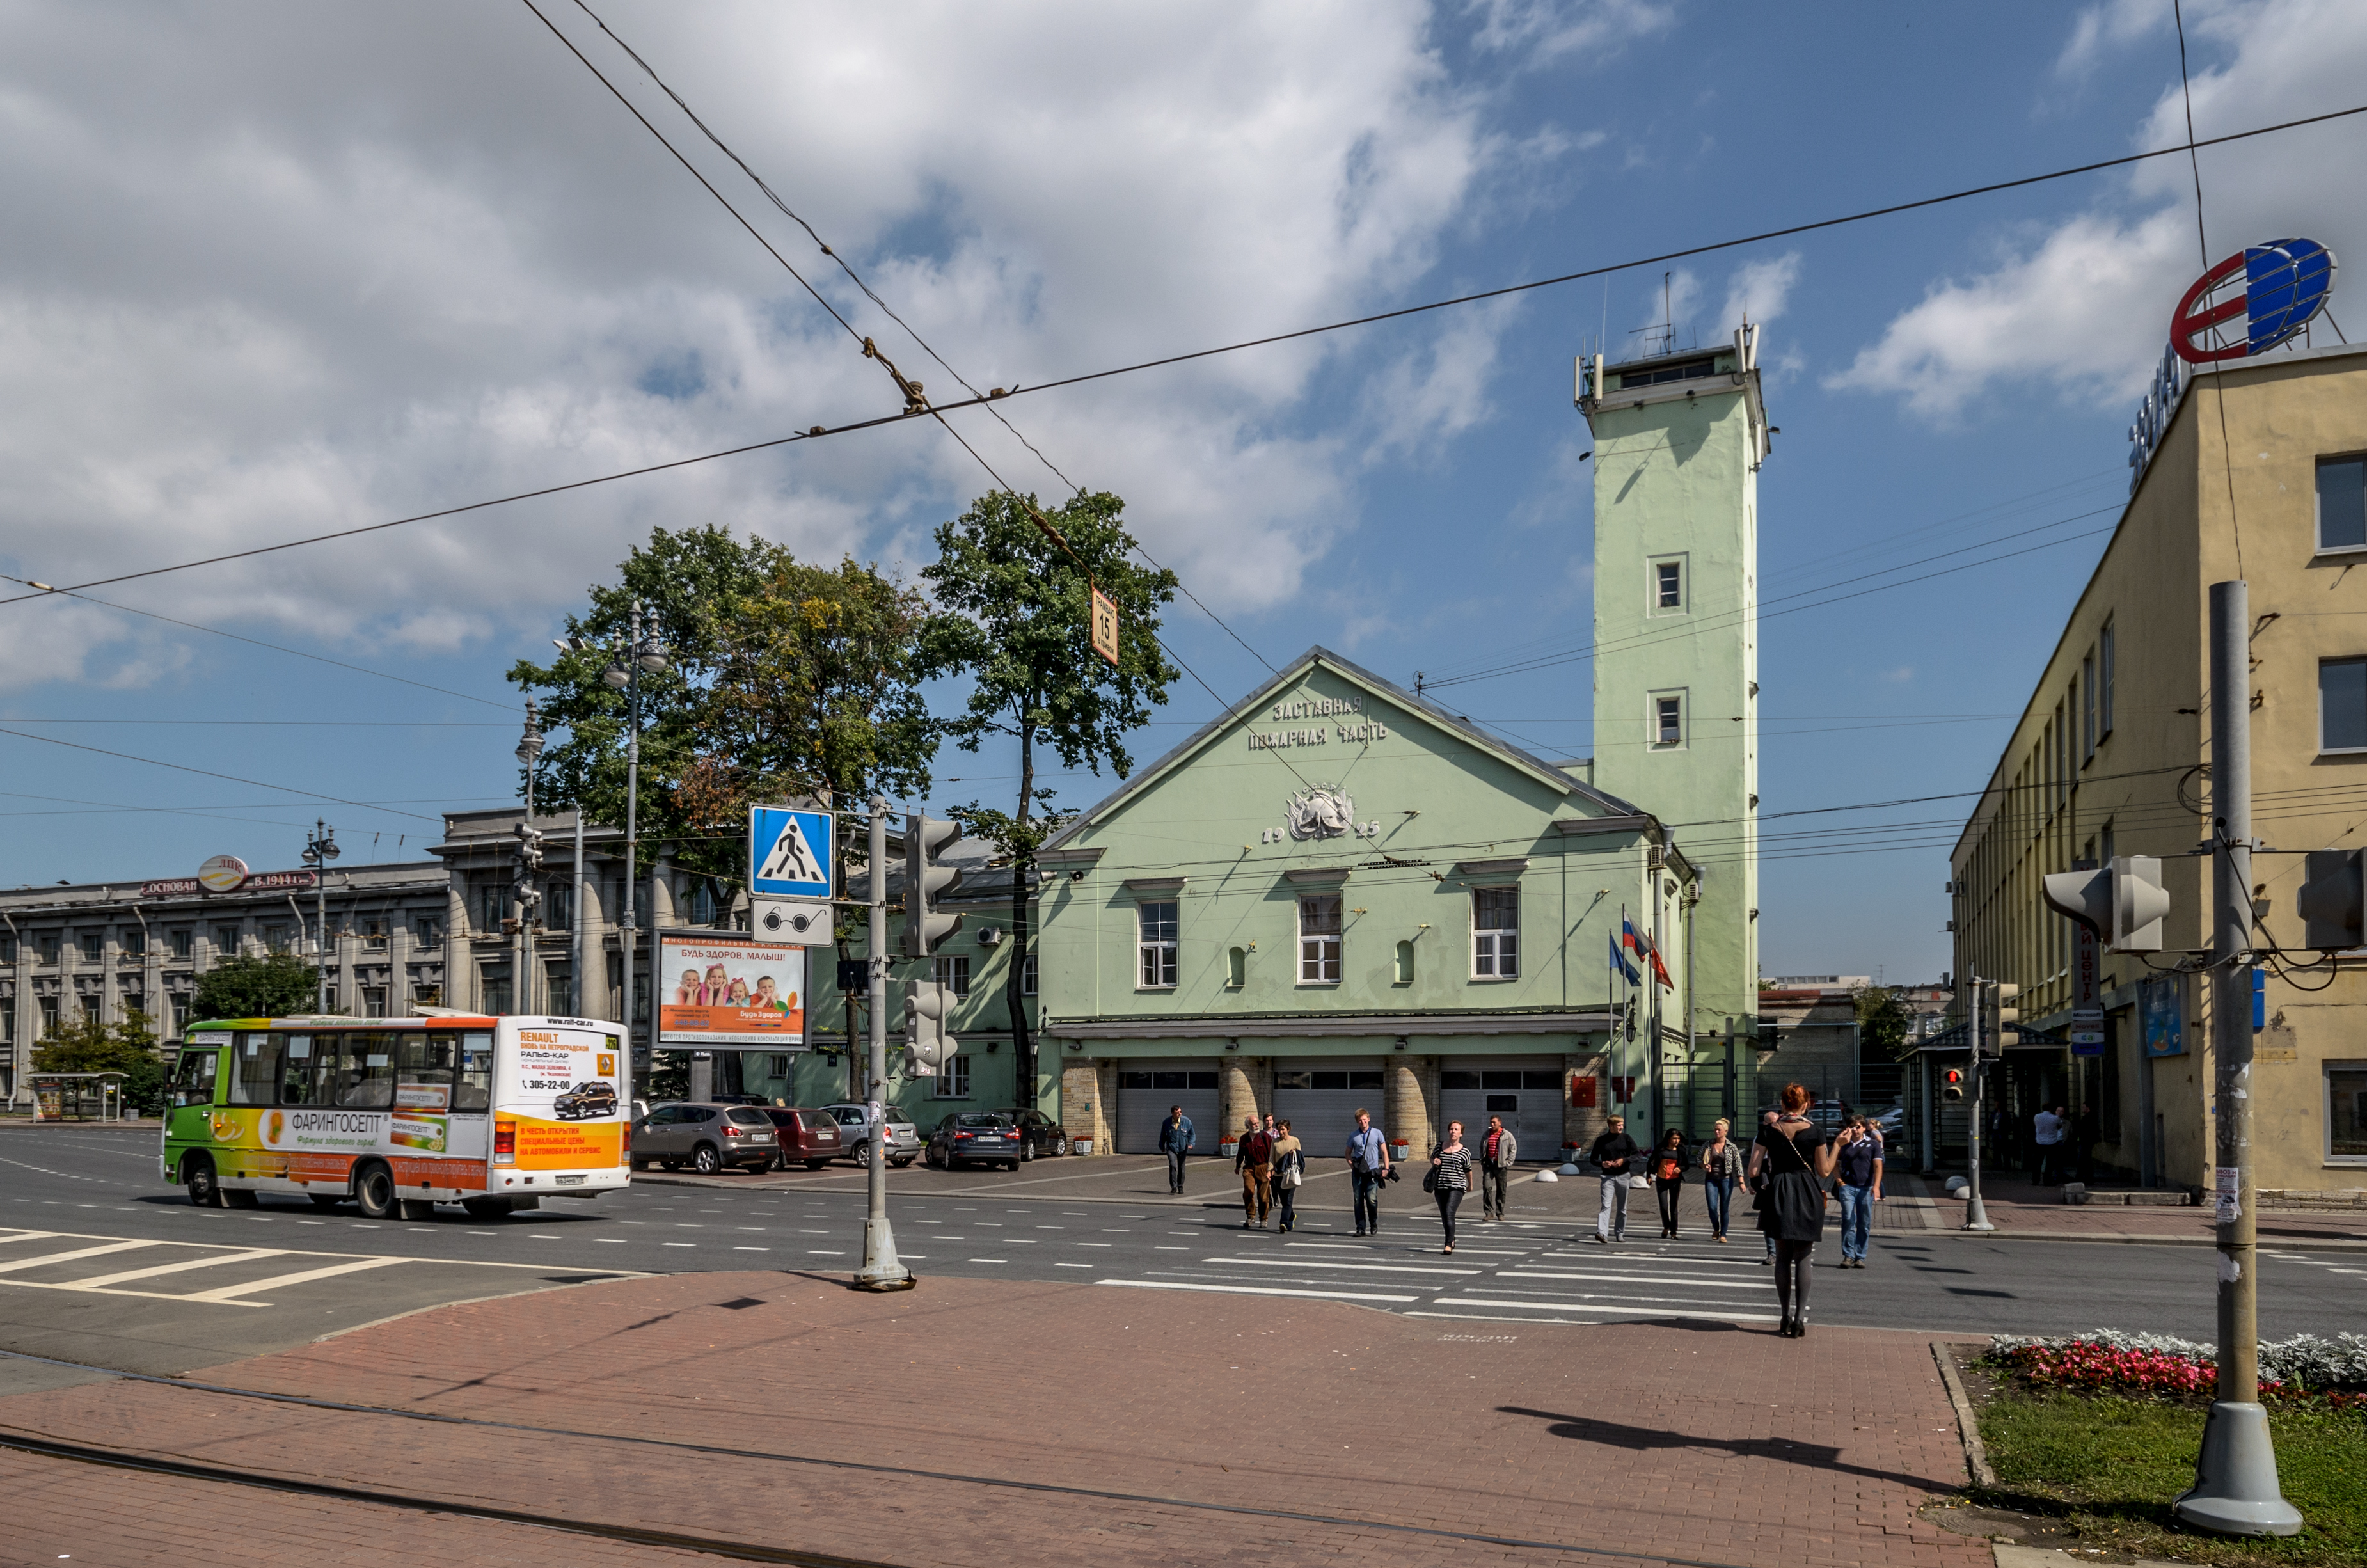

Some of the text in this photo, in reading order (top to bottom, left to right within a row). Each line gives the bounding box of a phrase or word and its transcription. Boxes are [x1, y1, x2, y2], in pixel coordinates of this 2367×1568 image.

[1096, 595, 1114, 619] ТРАМВАЮ
[1100, 613, 1109, 640] 15
[1101, 639, 1114, 655] кривой
[1274, 696, 1362, 719] ЗАСТАВНАЯ
[1249, 722, 1388, 749] ПОЖАРНАЯ ЧАСТЬ
[1262, 821, 1380, 843] 19 25
[219, 859, 241, 873] ЛПК
[149, 881, 197, 893] ОСНОВАН
[267, 874, 291, 885] 1944
[664, 938, 756, 947] МНОГОПРОФИЛЬНАЯ
[681, 949, 786, 961] БУДЬ ЗДОРОВ, МАЛЫШ!
[198, 1034, 231, 1042] ФАРИНГОСЕПТ
[520, 1031, 558, 1043] RENAULT
[548, 1044, 589, 1052] ПЕТРОГРАДСКОЙ
[530, 1080, 570, 1089] 305-22-00
[297, 1136, 377, 1147] Формула здорового горла!
[520, 1137, 566, 1146] СПЕЦИАЛЬНЫЕ
